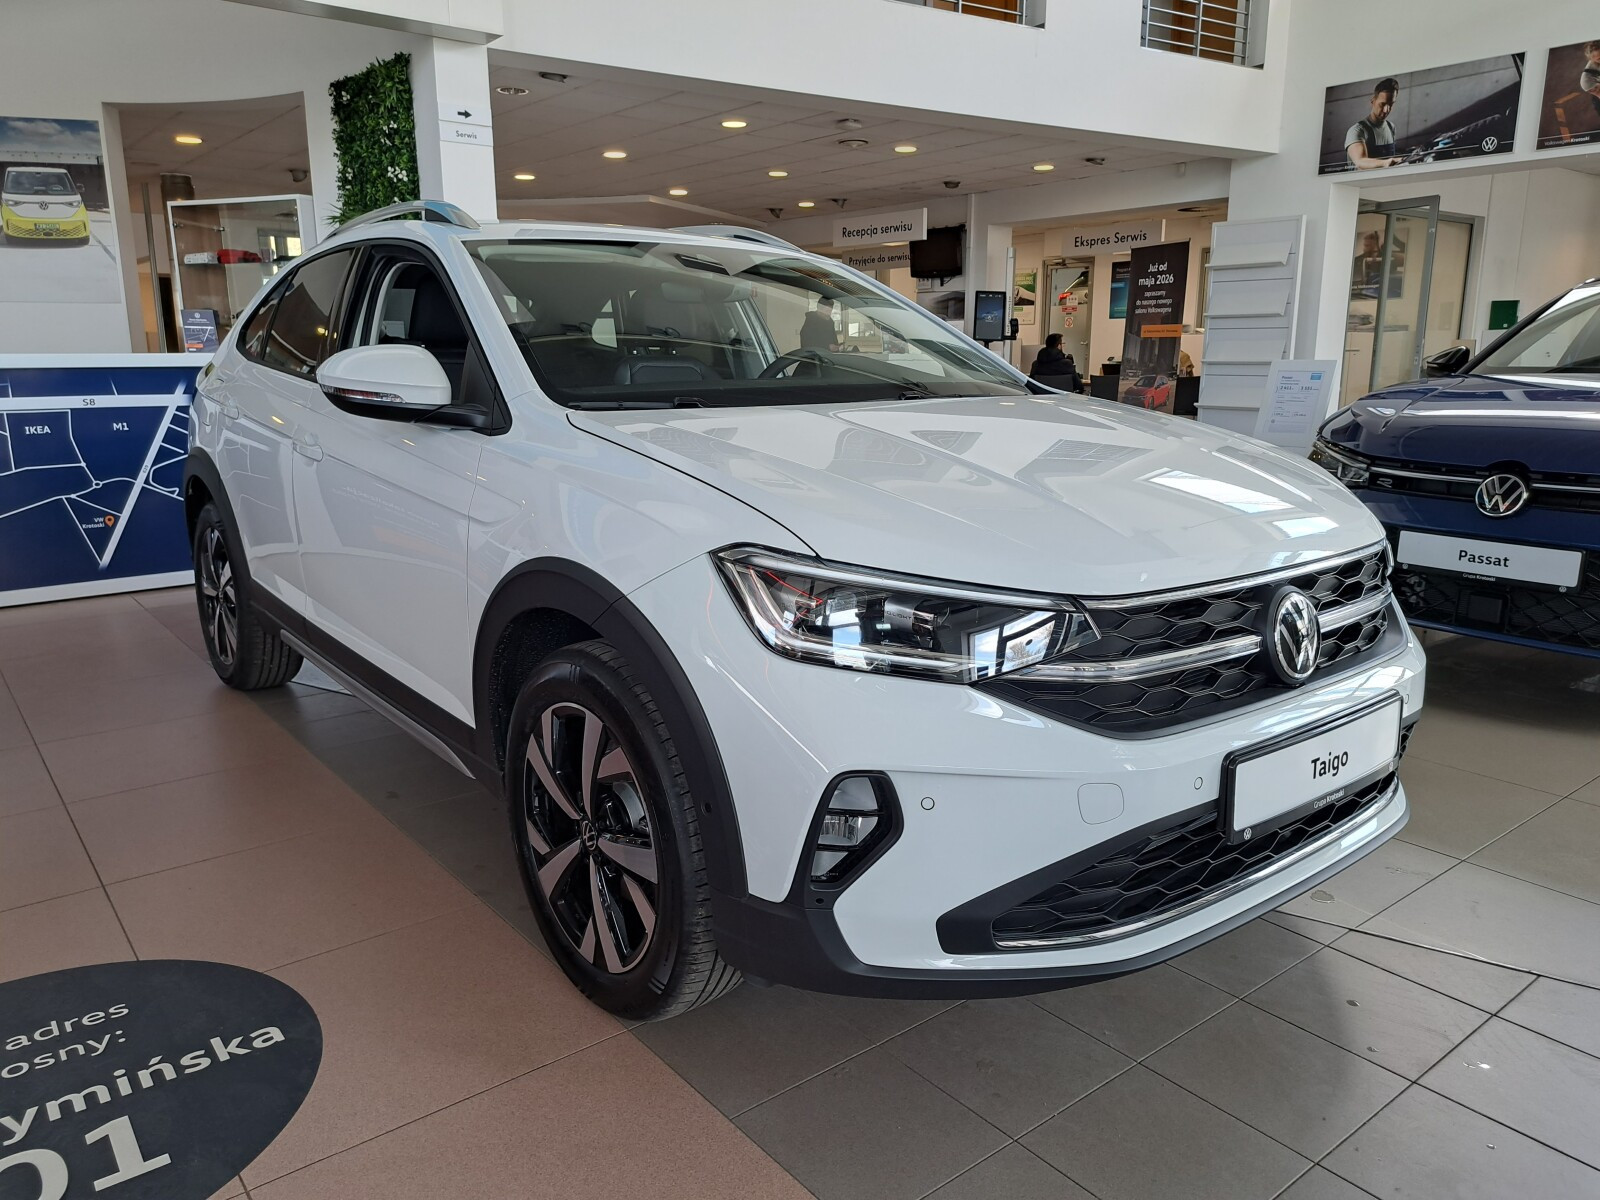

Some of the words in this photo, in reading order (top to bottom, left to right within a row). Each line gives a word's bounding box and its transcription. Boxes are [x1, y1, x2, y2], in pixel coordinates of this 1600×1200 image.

[456, 130, 477, 140] Serwis
[842, 225, 878, 239] Recepcja
[880, 221, 913, 234] serwisu
[1074, 235, 1111, 249] Ekspres
[1114, 230, 1147, 243] Serwis
[877, 254, 886, 263] do
[1158, 261, 1168, 271] od
[1138, 275, 1155, 288] maja
[1156, 273, 1174, 285] 2026
[82, 398, 96, 407] S8
[25, 426, 51, 435] IKEA
[113, 423, 129, 431] M1
[1458, 549, 1510, 568] Passat
[1310, 751, 1349, 780] Taigo
[5, 1003, 130, 1051] adres
[1, 1029, 126, 1079] osny:
